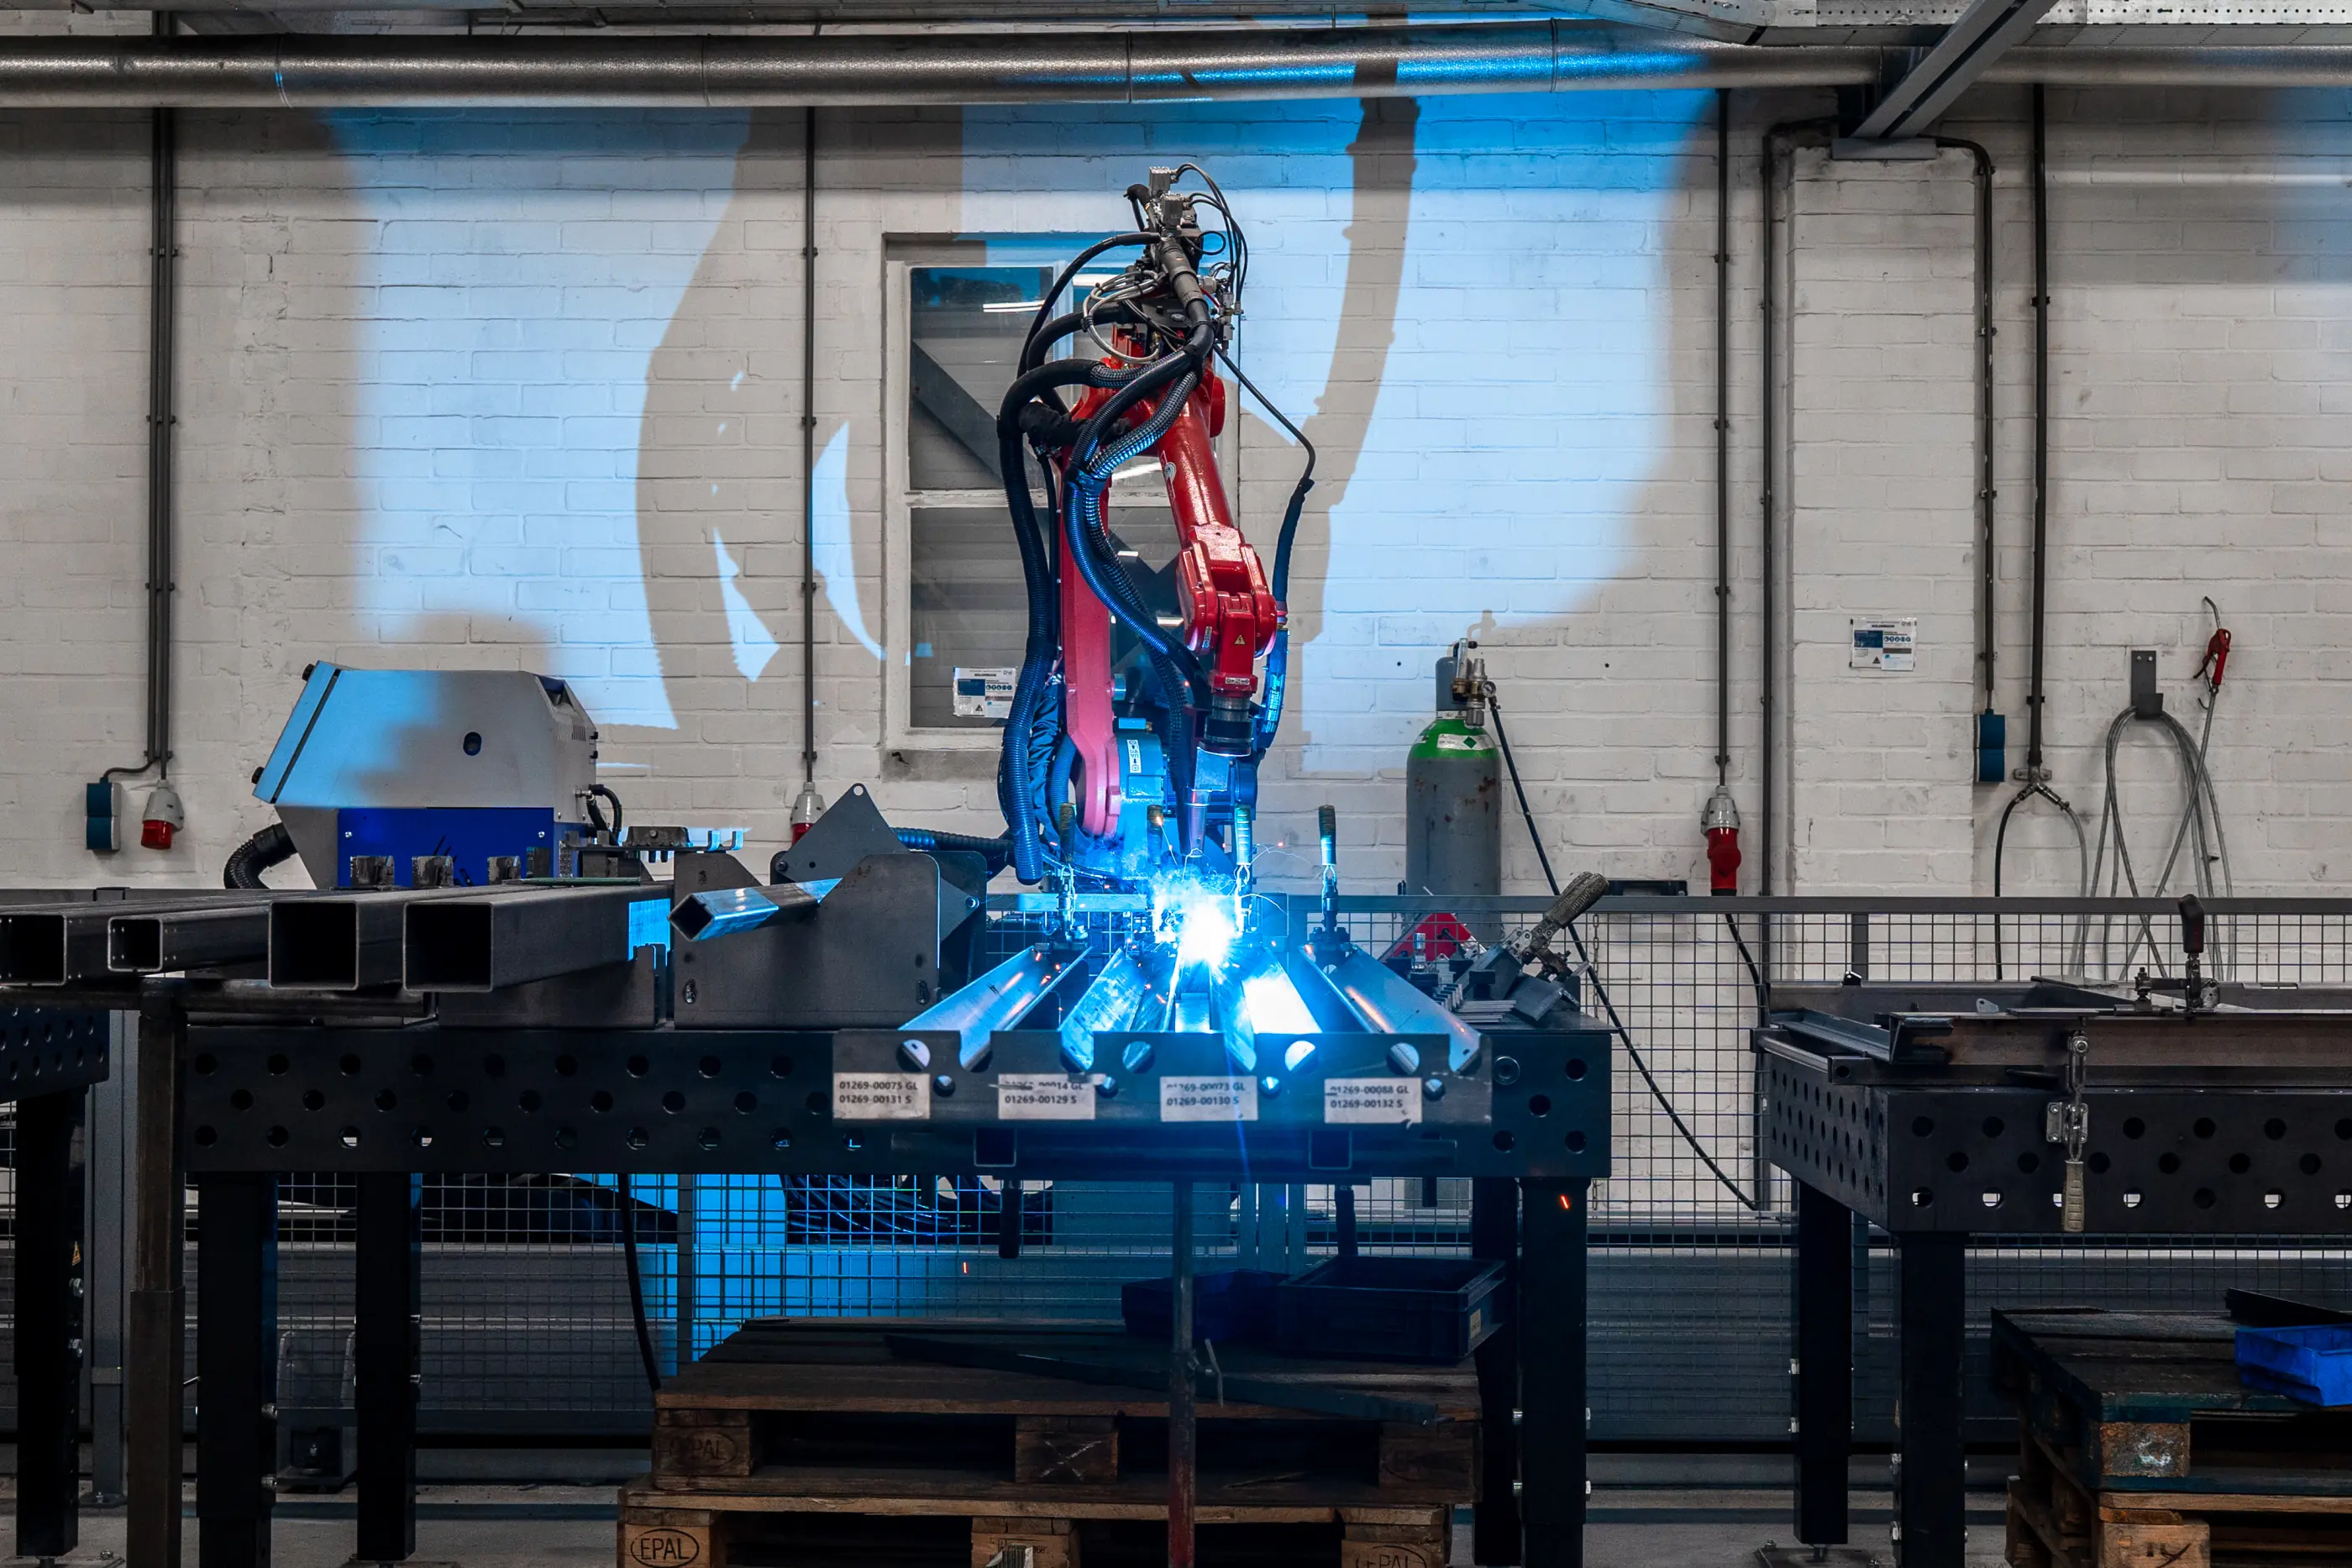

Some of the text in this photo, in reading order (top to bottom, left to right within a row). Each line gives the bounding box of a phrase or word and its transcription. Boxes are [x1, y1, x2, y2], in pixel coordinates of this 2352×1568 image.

[838, 1080, 918, 1090] 01269-00075 GL
[1396, 1085, 1409, 1094] GL
[838, 1094, 912, 1104] 01269-00131 S
[1004, 1095, 1078, 1104] 01269-00129 S
[1166, 1096, 1239, 1106] 01269-00130 S
[1330, 1099, 1403, 1108] 01269-00132 S
[641, 1537, 690, 1560] EPAL
